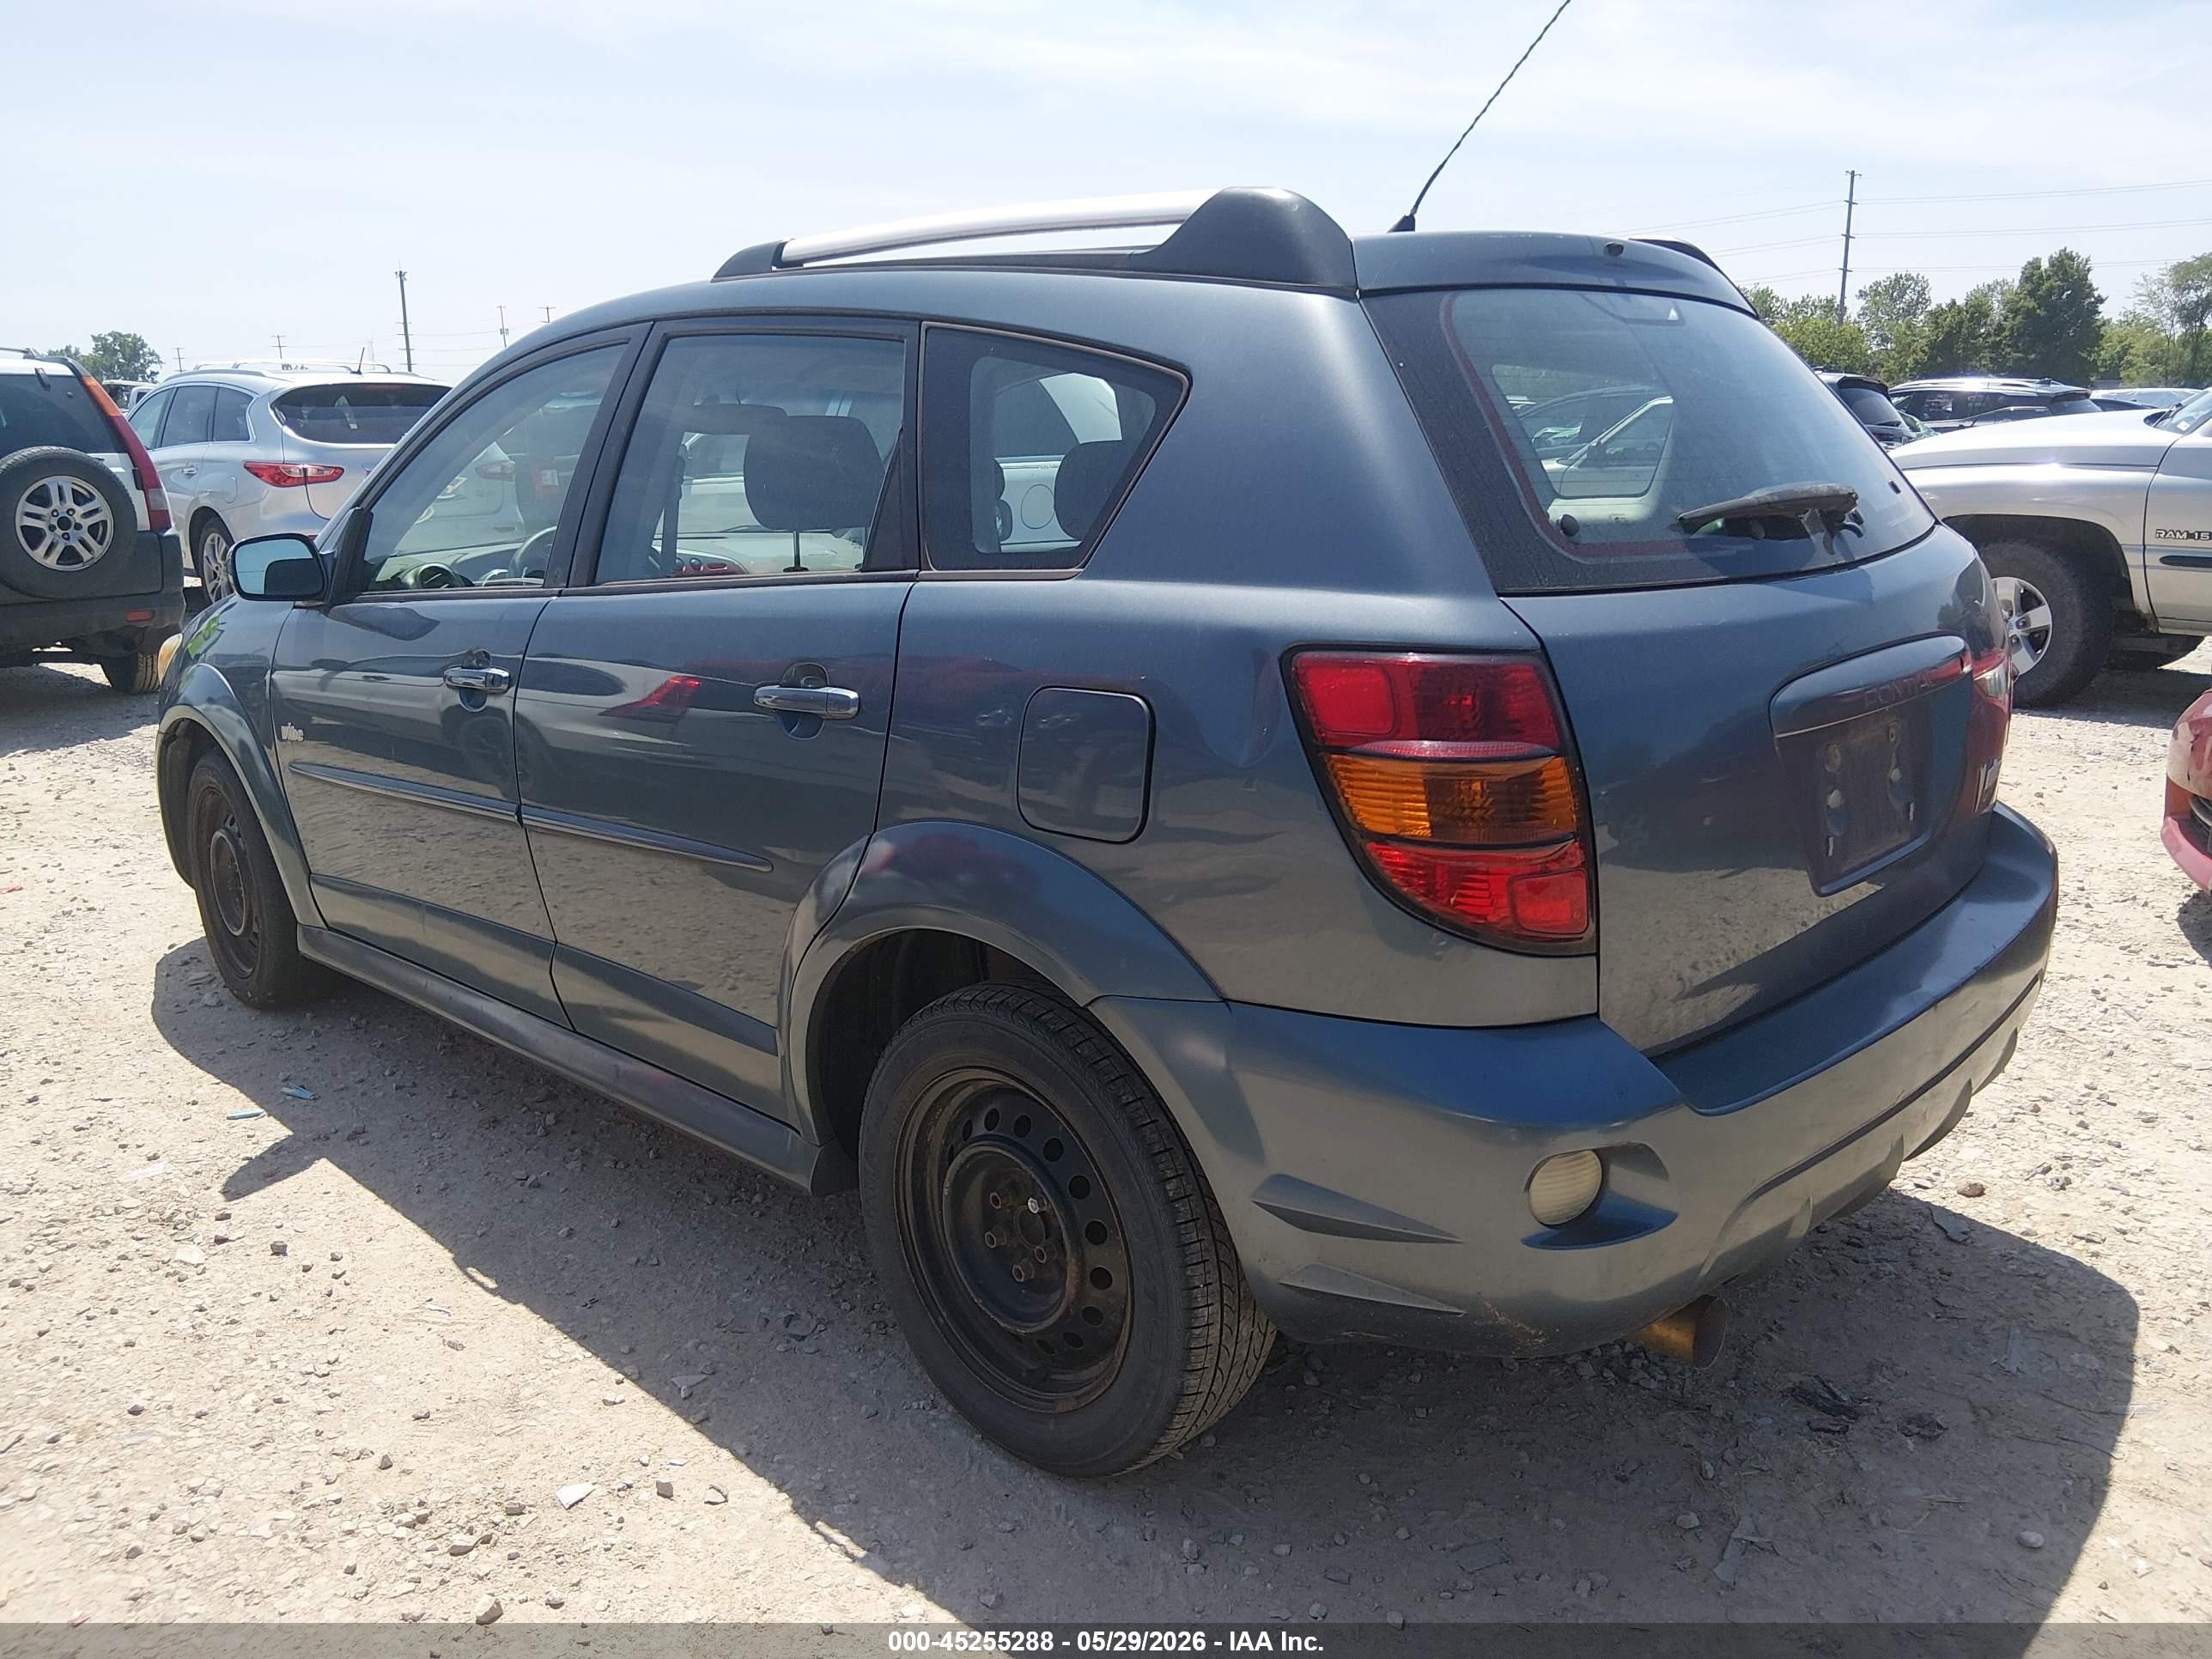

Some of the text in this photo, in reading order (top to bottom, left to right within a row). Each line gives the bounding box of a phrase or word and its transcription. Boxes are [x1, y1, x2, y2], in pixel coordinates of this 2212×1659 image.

[2155, 529, 2212, 541] RAM 15
[1863, 669, 1938, 708] PONTIAC
